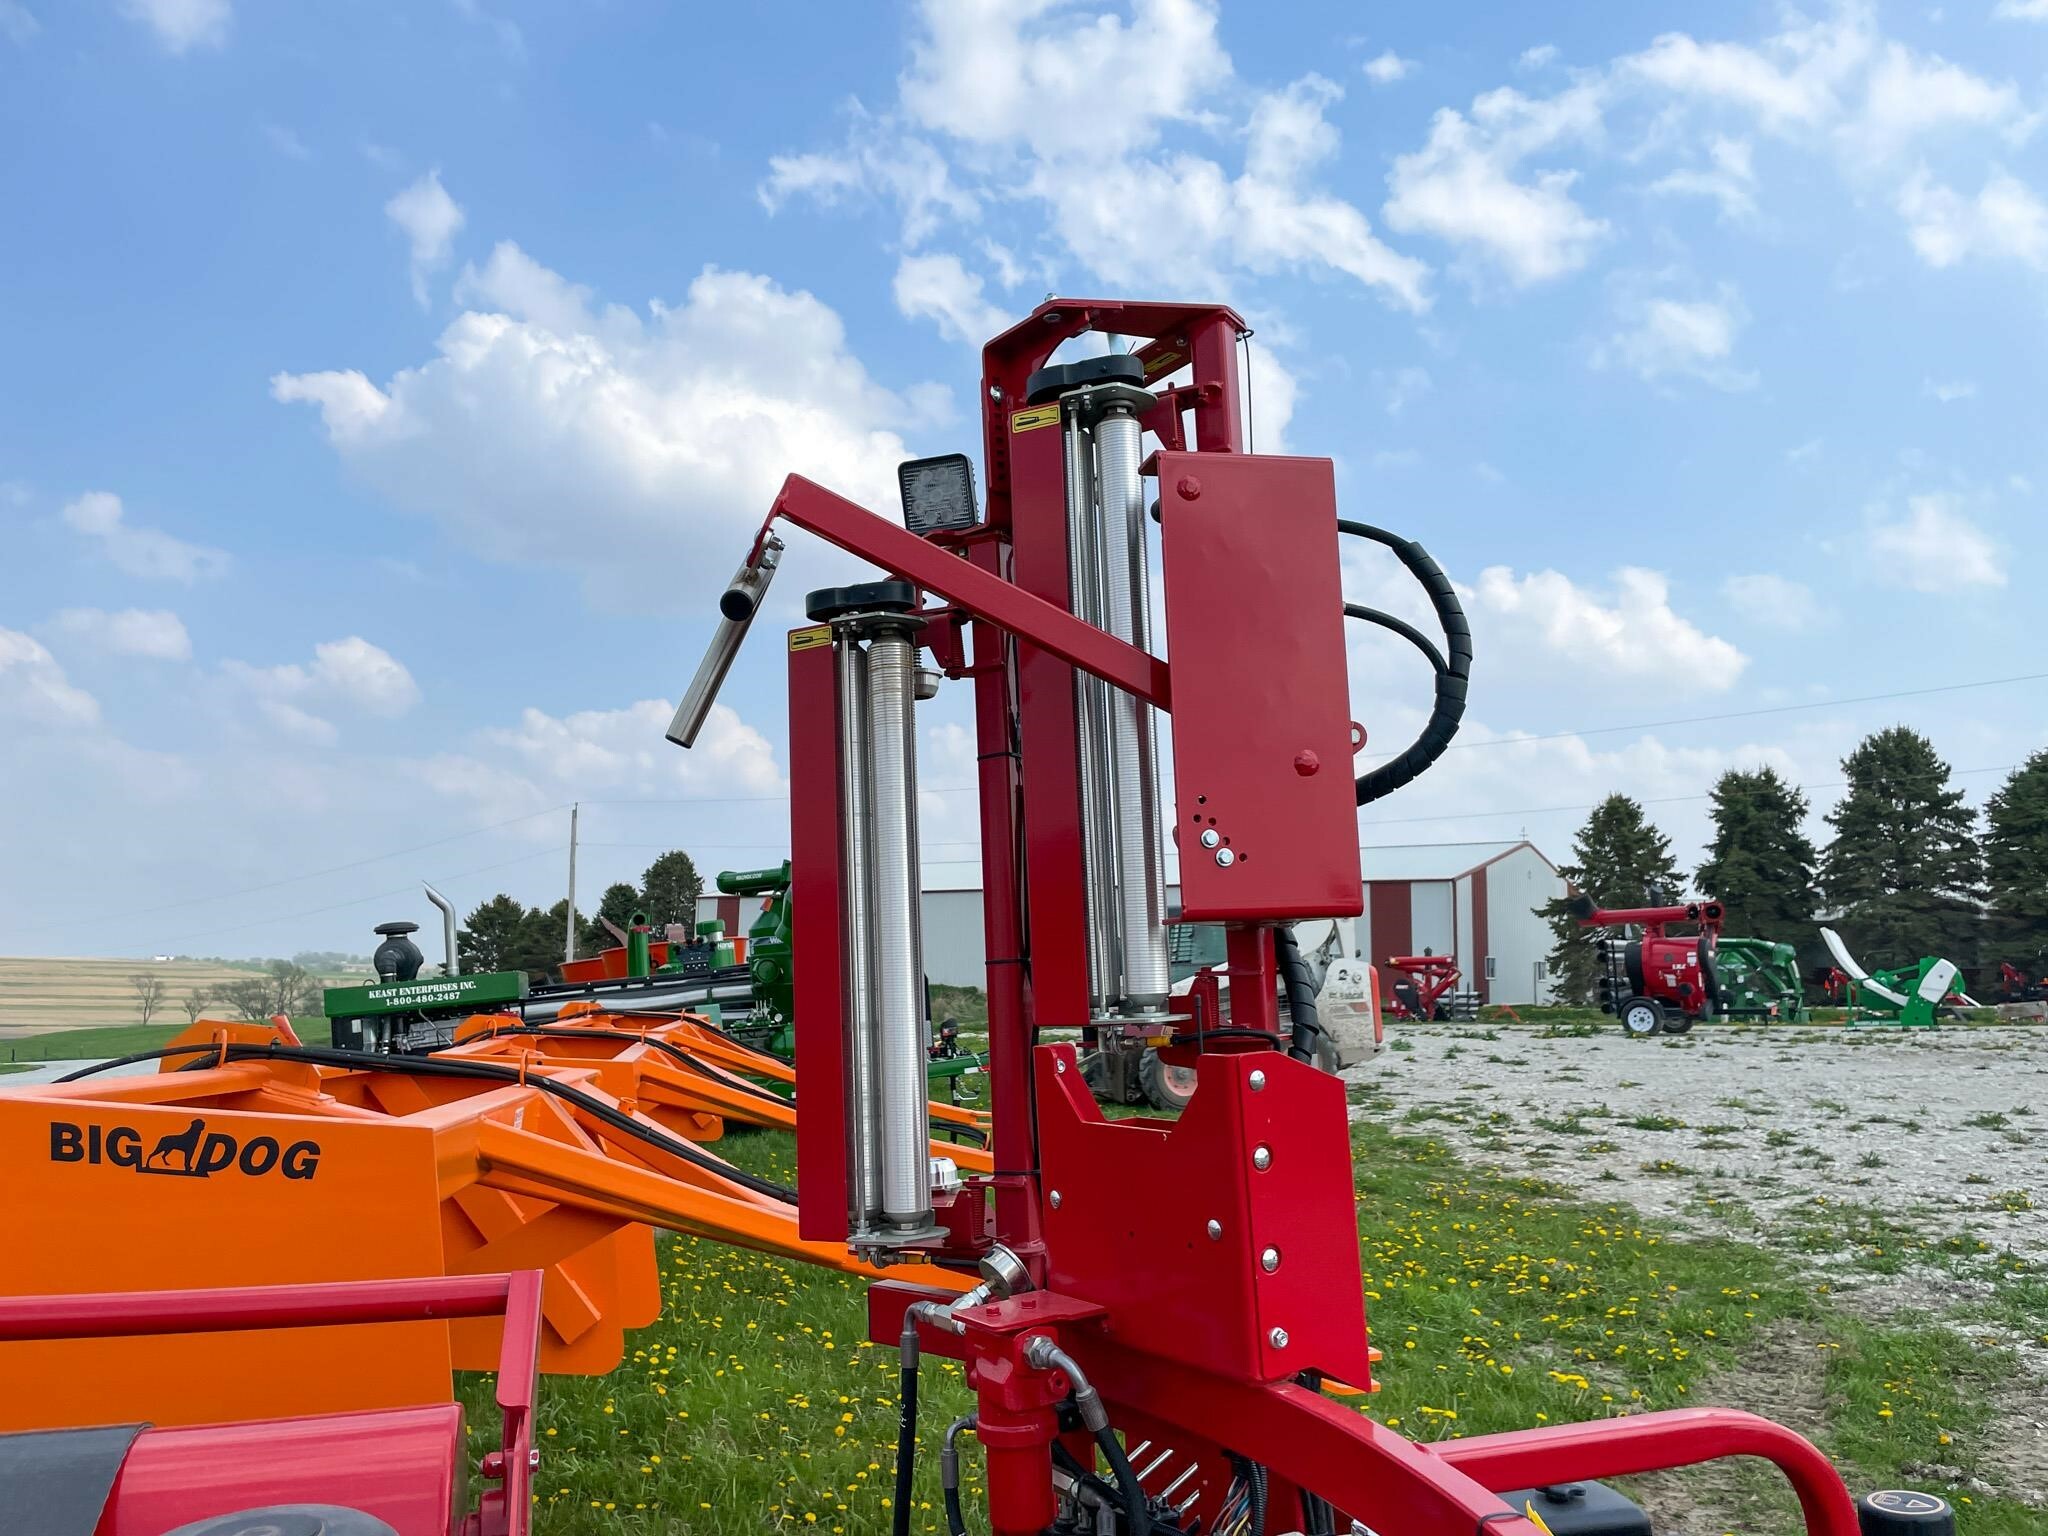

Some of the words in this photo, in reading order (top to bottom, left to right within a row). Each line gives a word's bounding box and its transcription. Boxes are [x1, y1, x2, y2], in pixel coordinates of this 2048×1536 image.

[369, 988, 397, 999] KEAST
[400, 983, 458, 996] ENTERPRISES
[460, 981, 477, 989] INC.
[386, 992, 460, 1006] 1-800-480-2487
[50, 1122, 143, 1167] BIG
[197, 1132, 321, 1180] DOG
